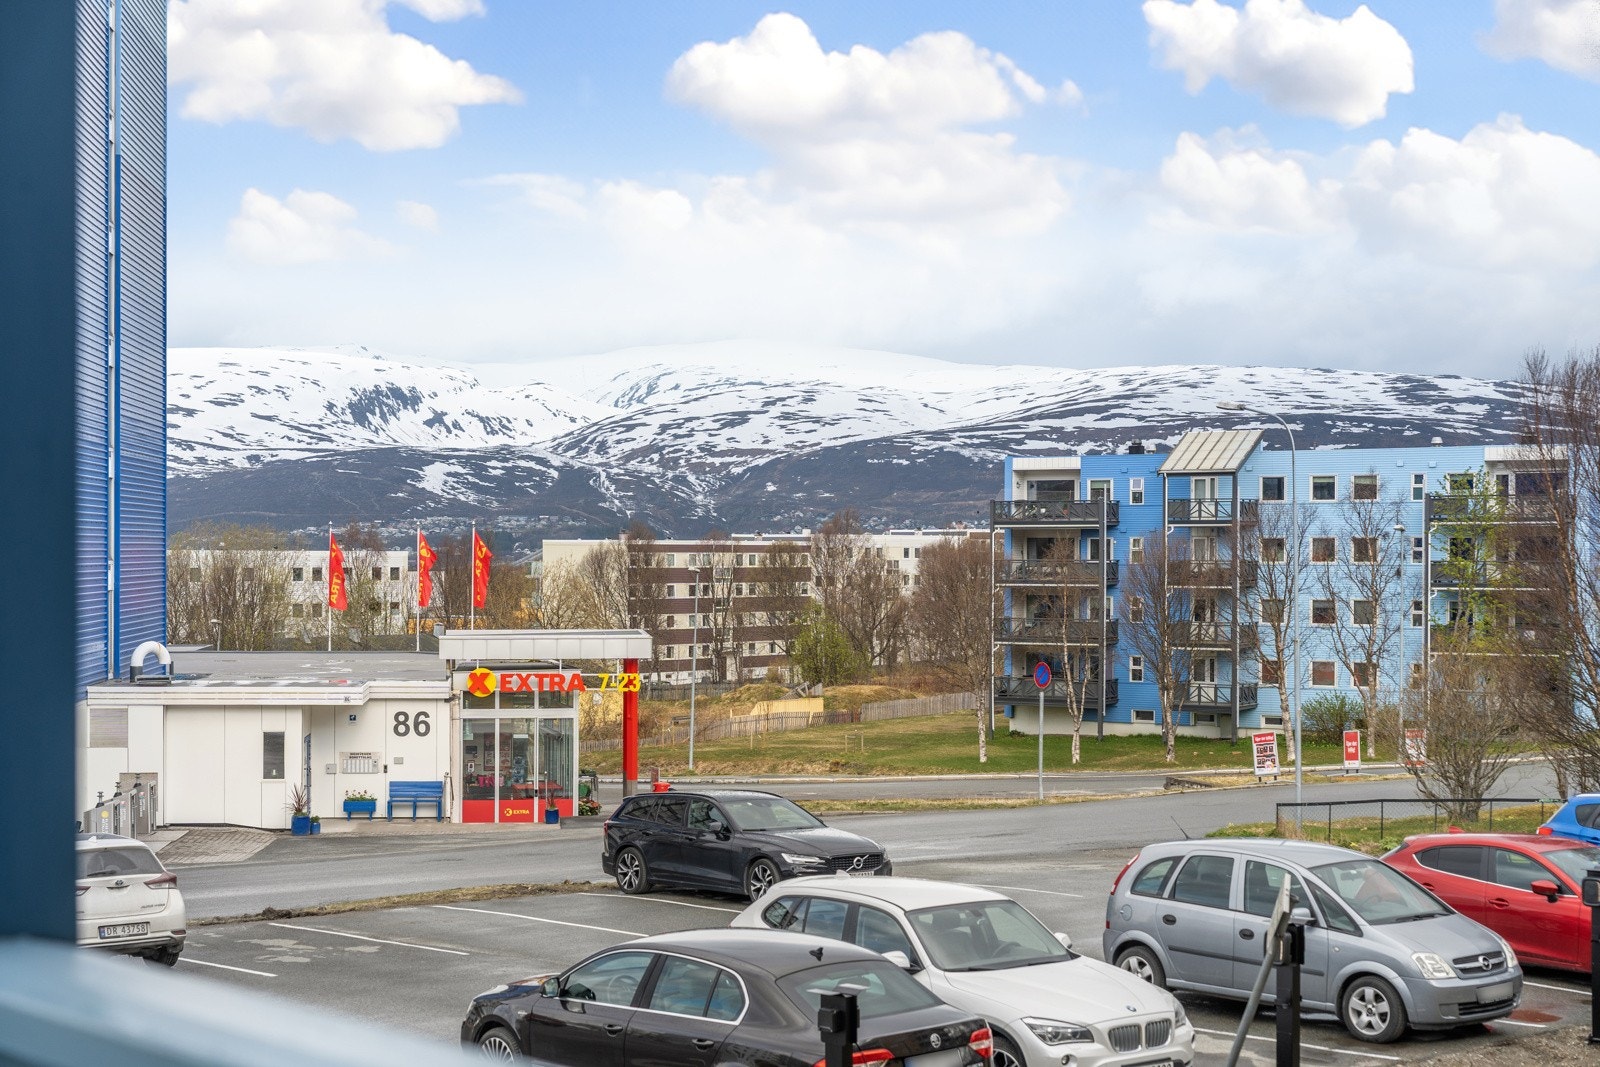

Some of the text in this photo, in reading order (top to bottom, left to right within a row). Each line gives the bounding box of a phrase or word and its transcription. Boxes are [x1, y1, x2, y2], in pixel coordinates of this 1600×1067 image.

[500, 673, 586, 692] EXTRA
[598, 673, 641, 692] 7-23
[393, 711, 431, 737] 86
[106, 924, 146, 936] DR 43758
